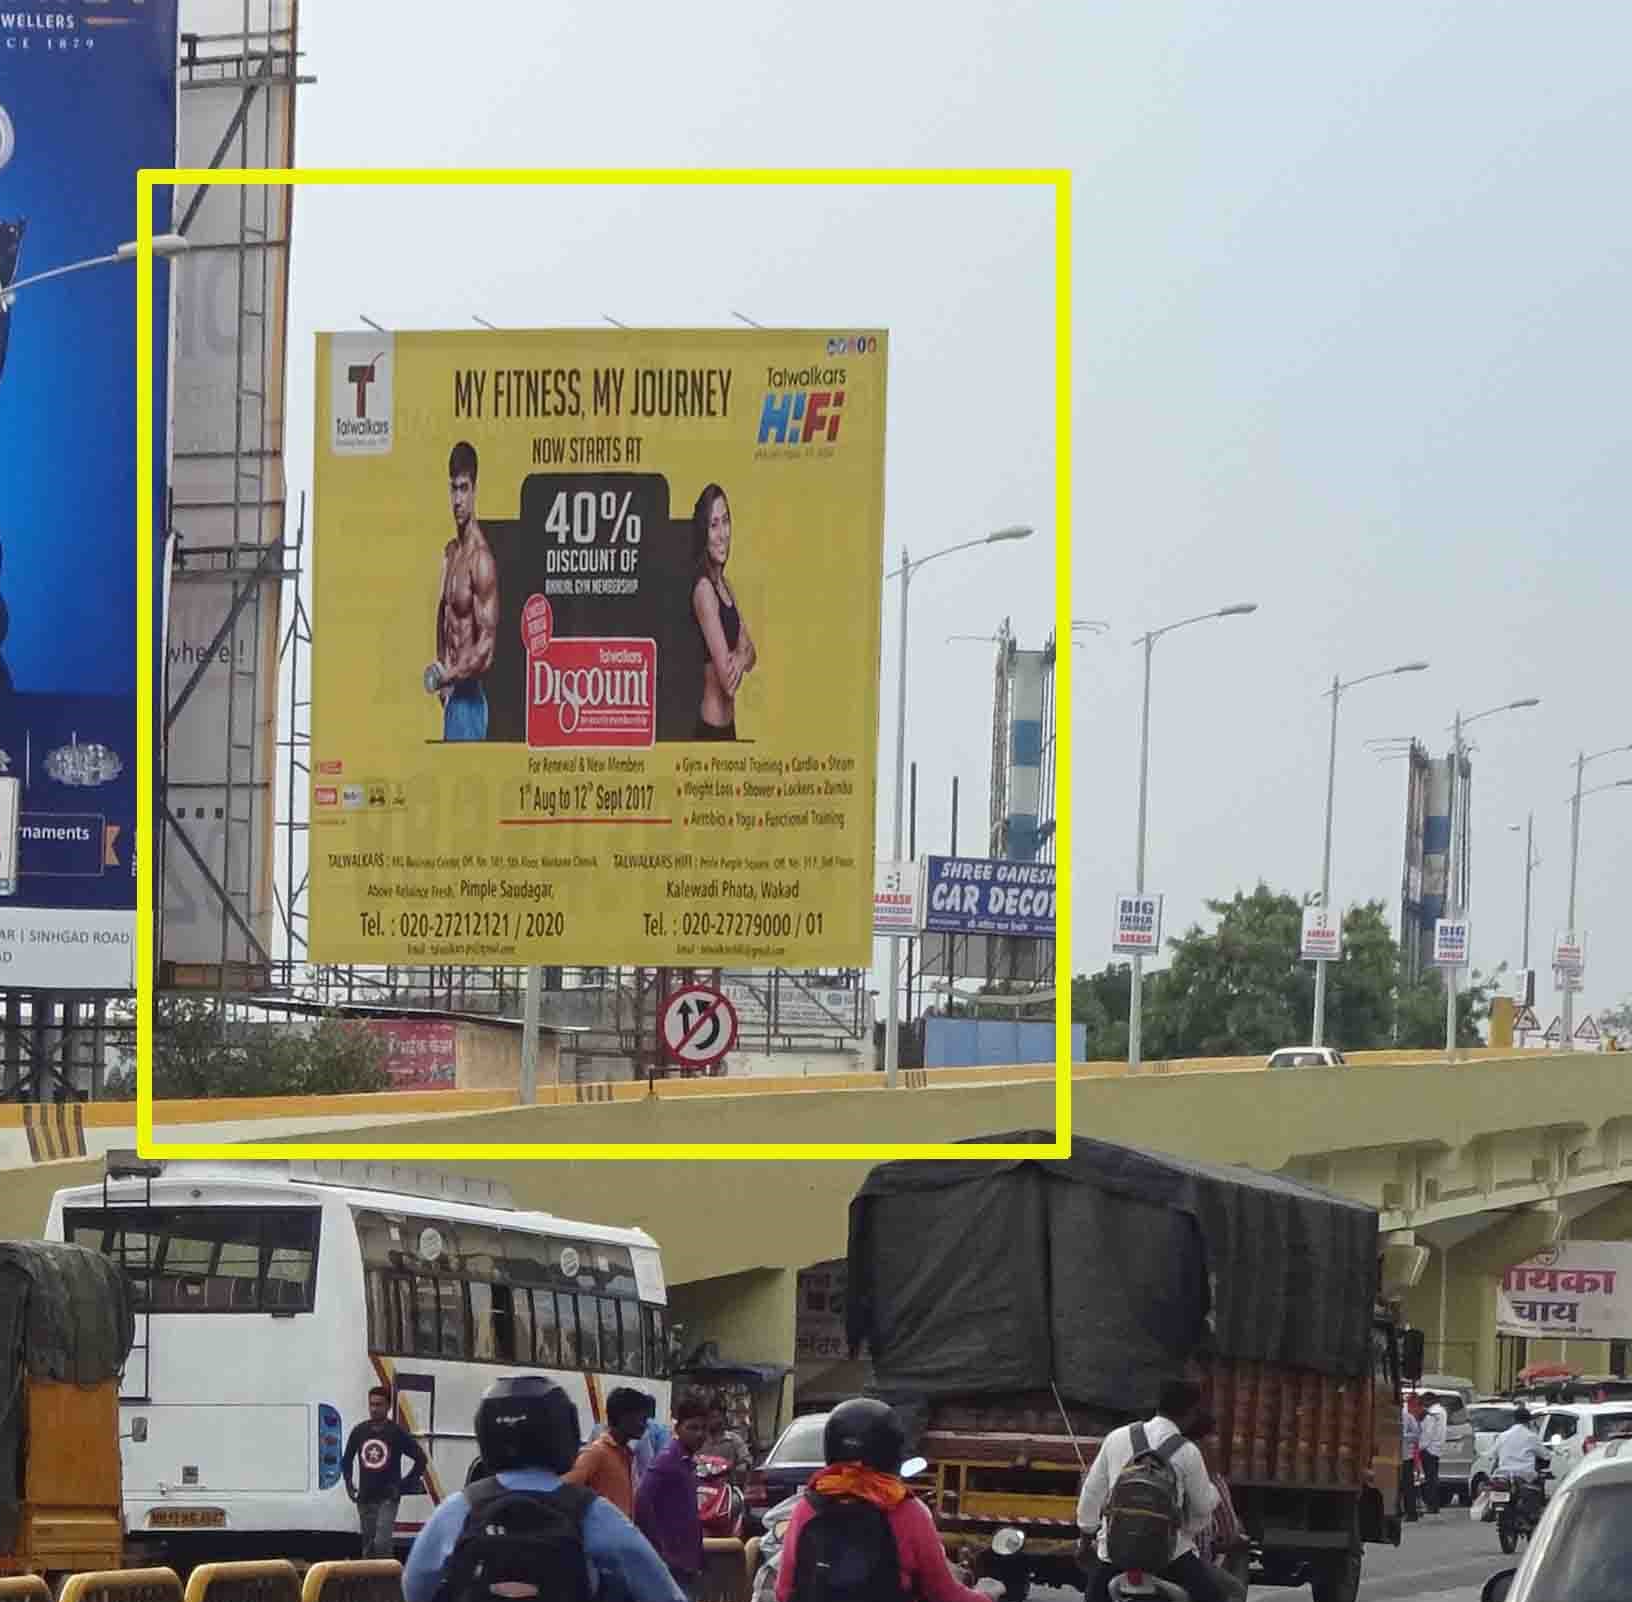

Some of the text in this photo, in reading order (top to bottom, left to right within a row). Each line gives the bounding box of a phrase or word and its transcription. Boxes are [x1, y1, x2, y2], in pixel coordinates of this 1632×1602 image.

[455, 368, 732, 420] MY FITNESS, MY JOURNEY
[532, 437, 643, 464] NOW STARTS AT
[544, 491, 641, 544] 40%
[546, 549, 639, 573] DISCOUNT OF
[533, 660, 649, 734] Discount
[542, 757, 575, 773] Renewal
[608, 757, 646, 773] Members
[534, 785, 556, 815] Aug
[558, 787, 570, 811] to
[596, 786, 623, 815] Sept
[625, 785, 655, 811] 2017
[940, 862, 993, 881] SHREE
[460, 880, 497, 904] Pimple
[666, 879, 800, 901] Kalewadi Phata, Wakad
[931, 882, 980, 914] CAR
[30, 931, 88, 944] SINHGAD
[93, 932, 131, 945] ROAD
[360, 912, 385, 938] Tel.
[400, 911, 510, 938] 020-27212121
[526, 911, 566, 937] 2020
[644, 912, 668, 937] Tel.
[682, 911, 791, 938] 020-27279000
[805, 911, 824, 936] 01
[1511, 1300, 1581, 1323] चाय
